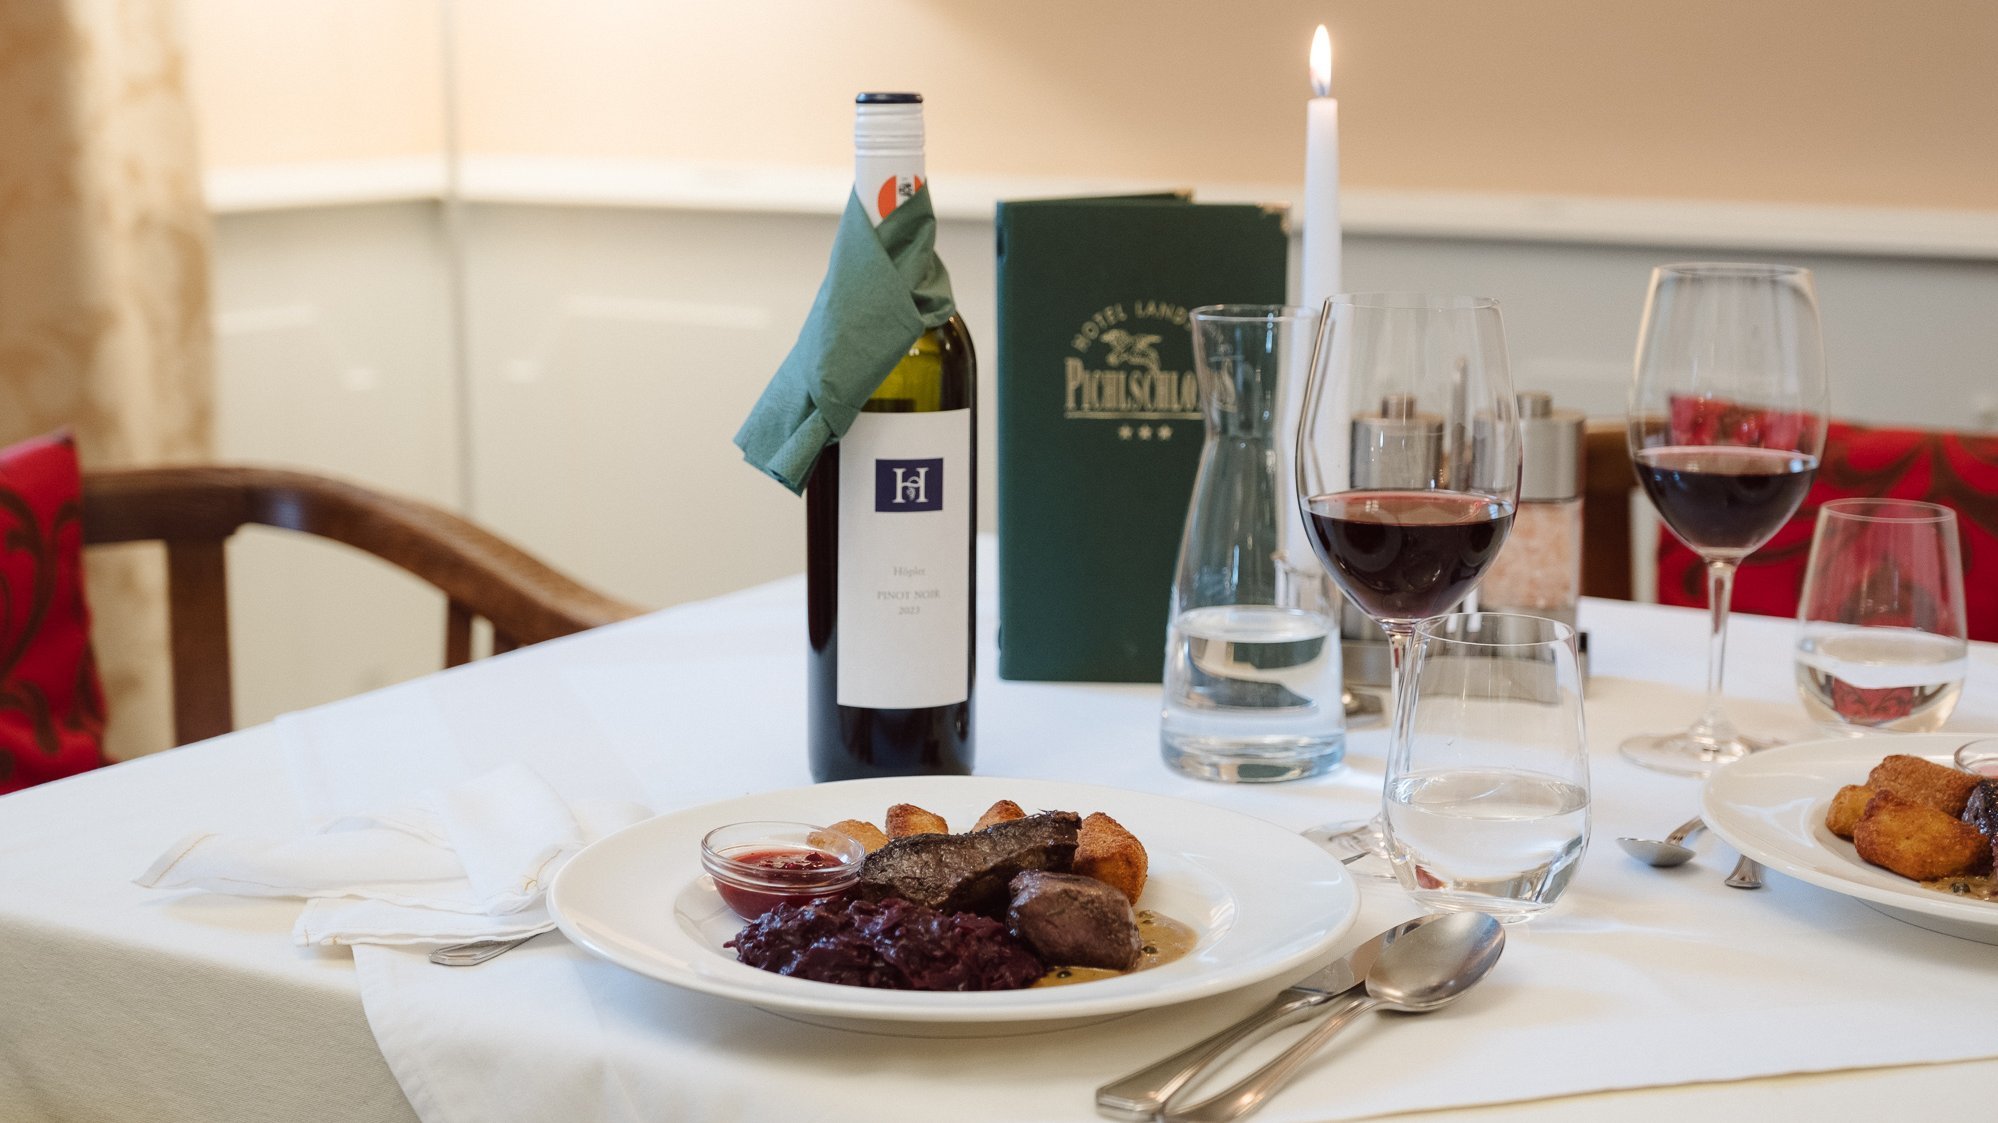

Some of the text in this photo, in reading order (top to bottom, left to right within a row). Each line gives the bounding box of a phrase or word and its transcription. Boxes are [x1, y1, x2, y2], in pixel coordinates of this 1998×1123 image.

[1071, 303, 1128, 353] HOTEL
[877, 588, 941, 600] PINOT NOIR
